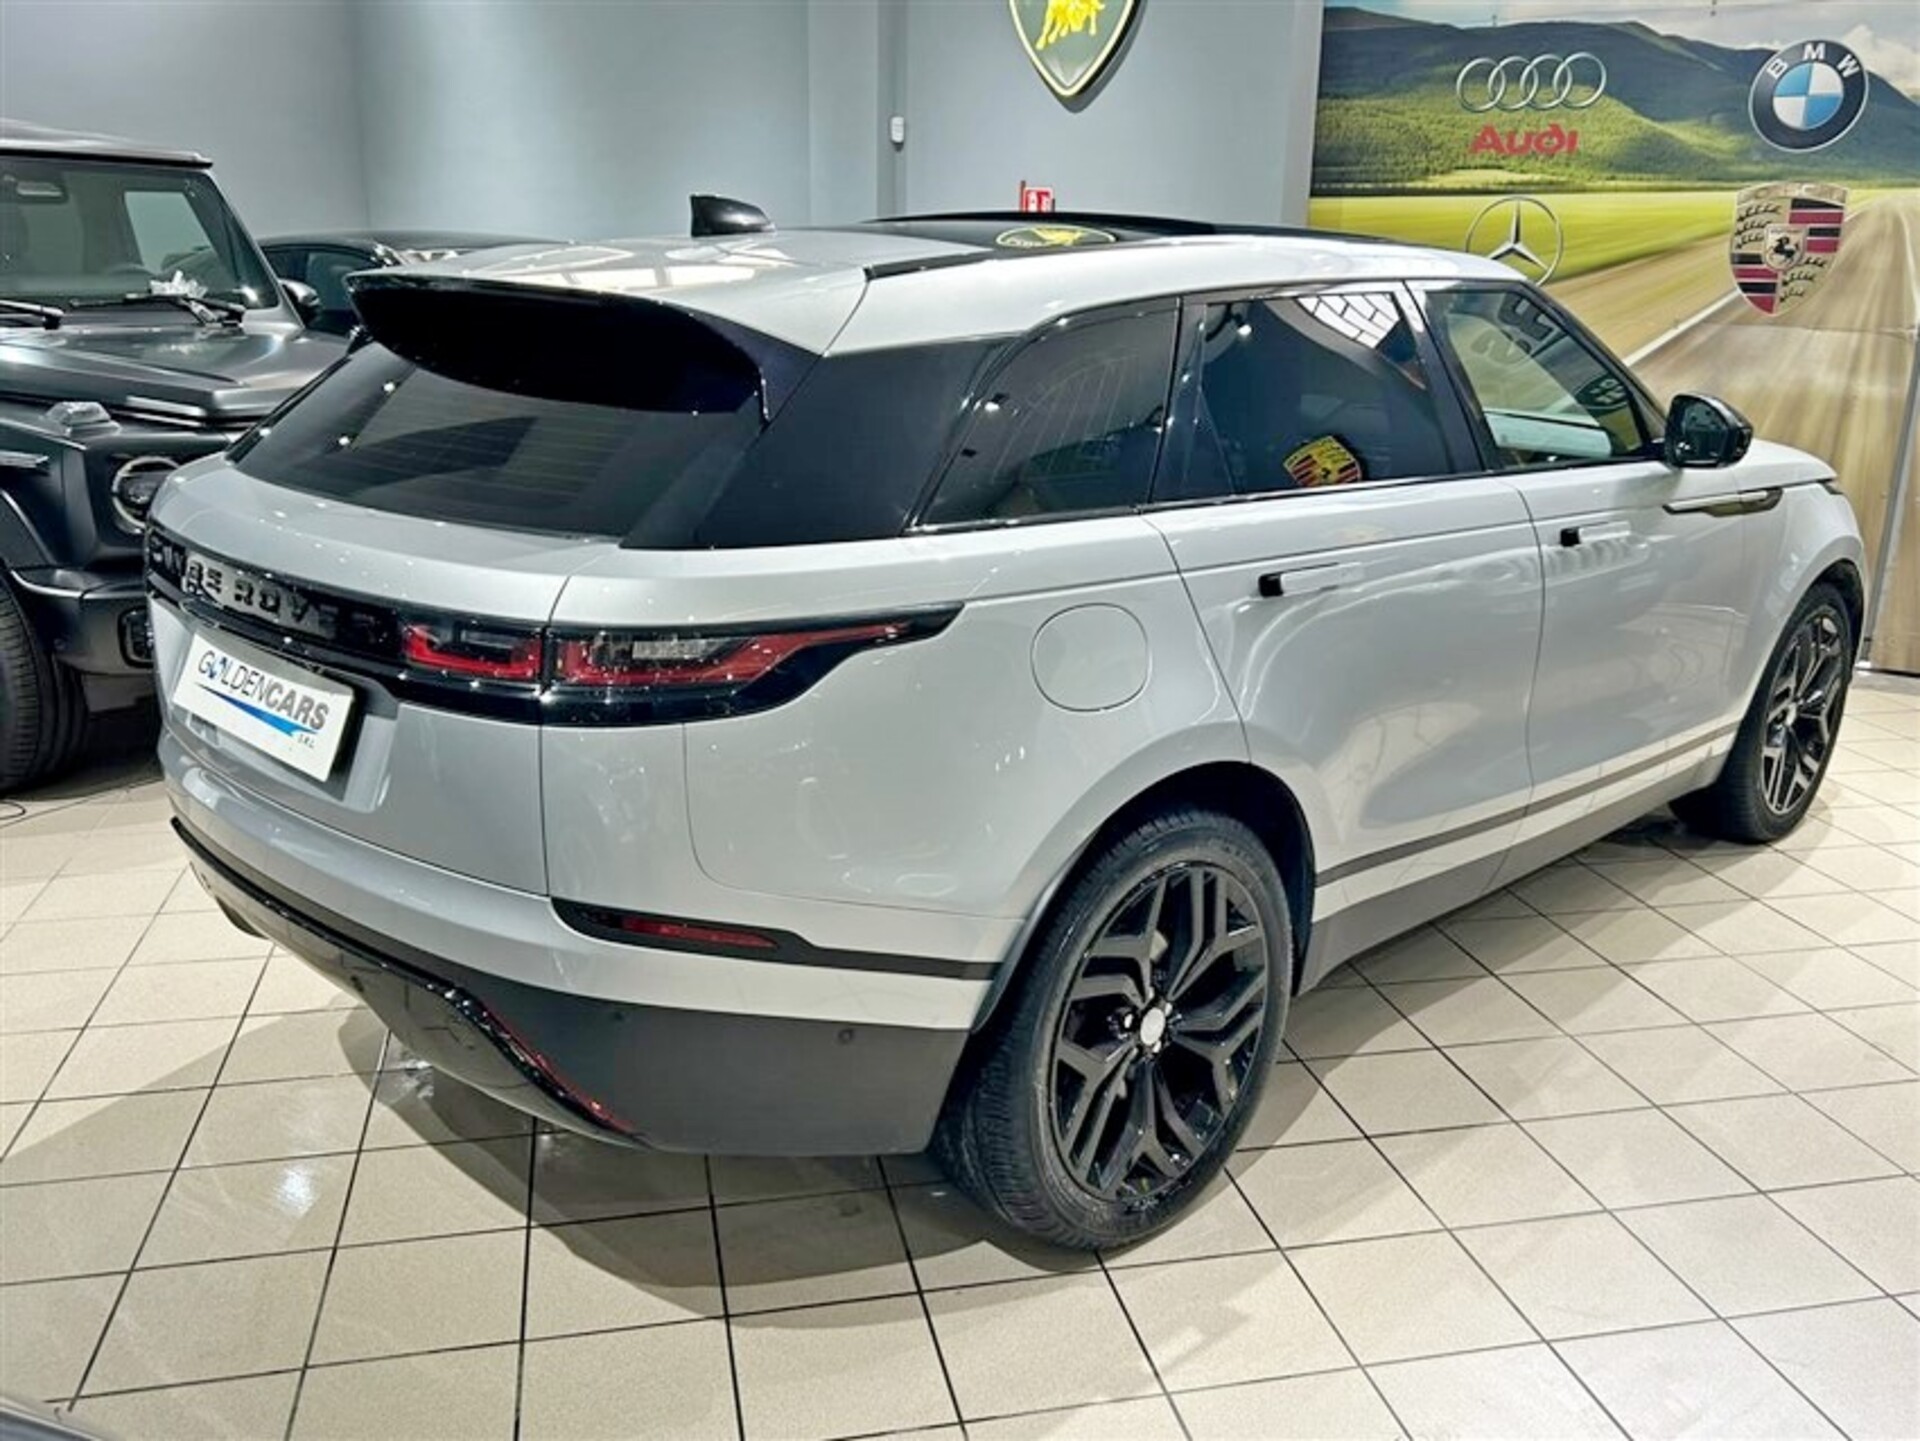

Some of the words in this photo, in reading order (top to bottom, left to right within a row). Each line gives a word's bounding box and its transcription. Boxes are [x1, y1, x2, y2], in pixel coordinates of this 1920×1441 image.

[1765, 42, 1861, 80] BMW
[1468, 122, 1579, 155] Audi
[197, 650, 330, 731] GOLDENCARS
